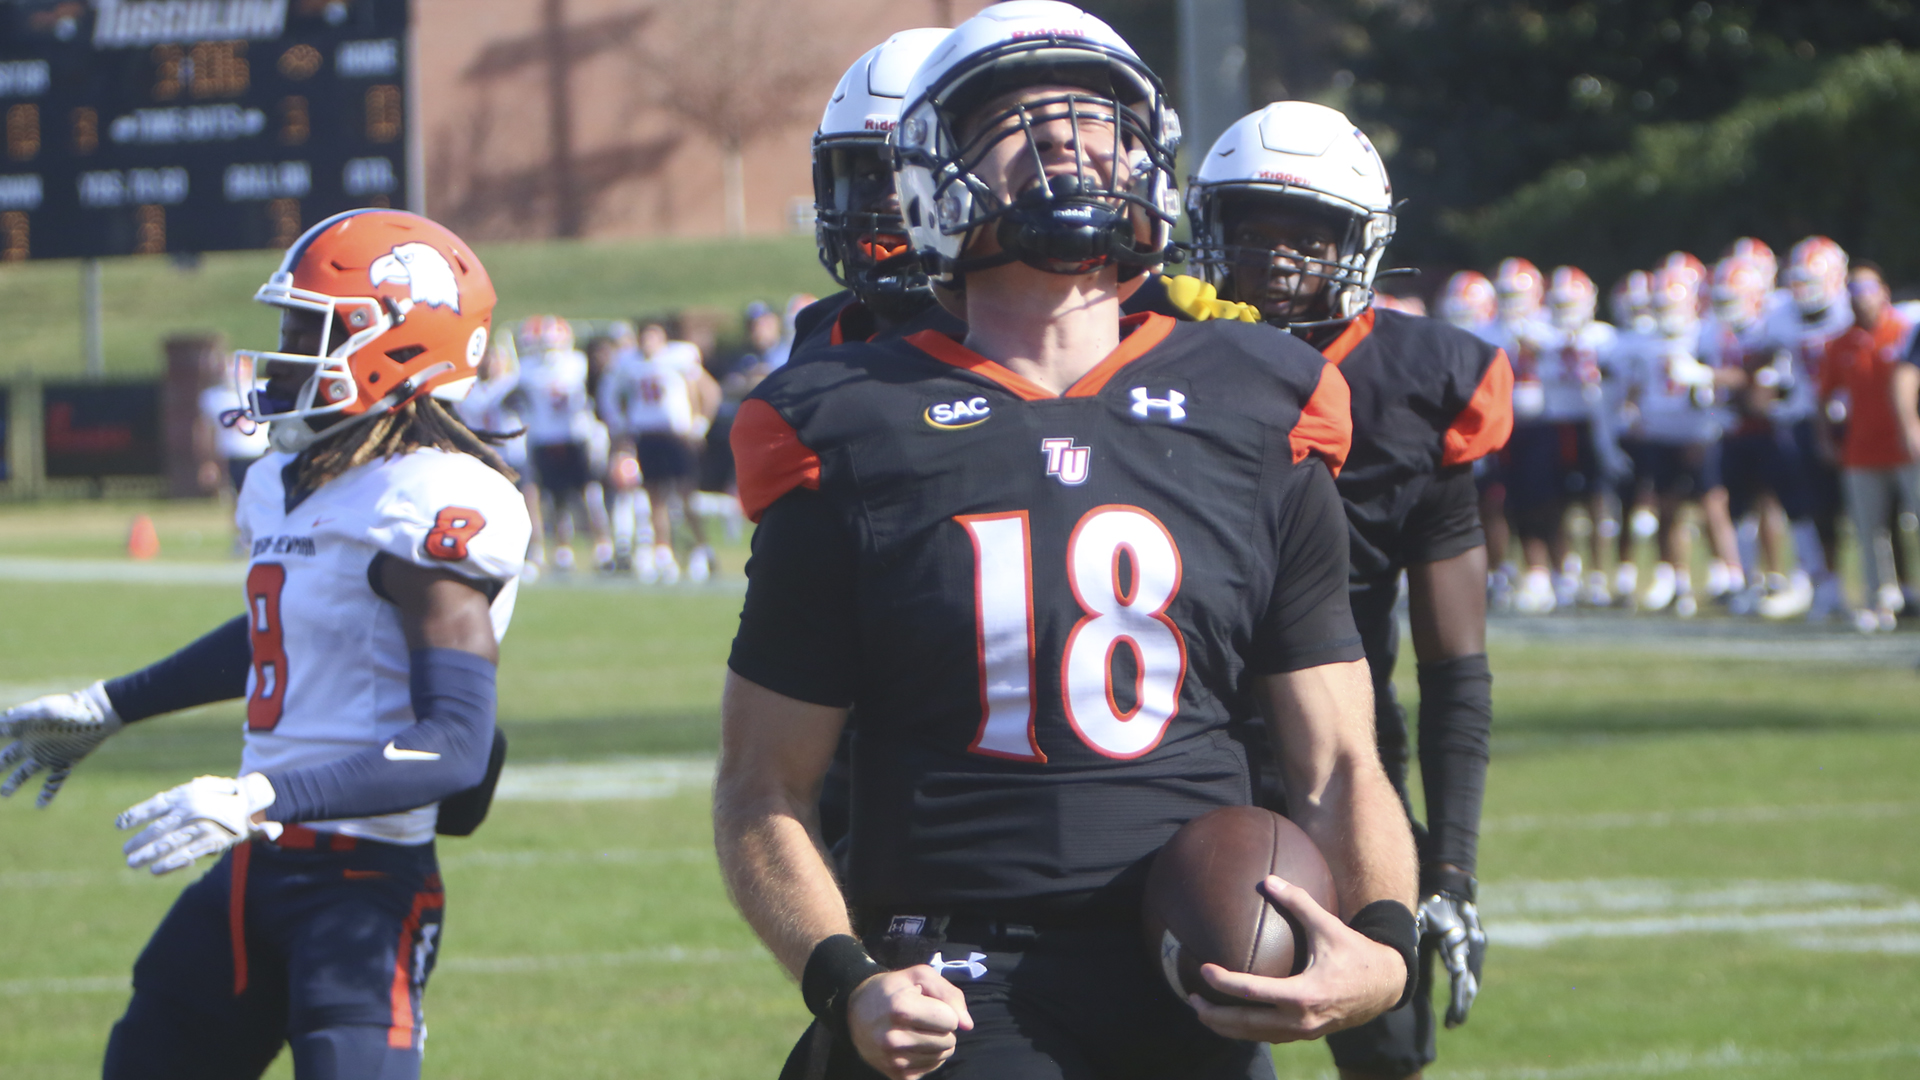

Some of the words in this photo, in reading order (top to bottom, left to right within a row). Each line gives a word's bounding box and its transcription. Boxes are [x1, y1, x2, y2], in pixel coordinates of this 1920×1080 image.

[865, 119, 898, 131] Ridd
[933, 396, 991, 423] SAC
[1042, 437, 1091, 485] TU
[423, 504, 487, 562] 8
[246, 562, 290, 733] 8
[951, 503, 1188, 764] 18
